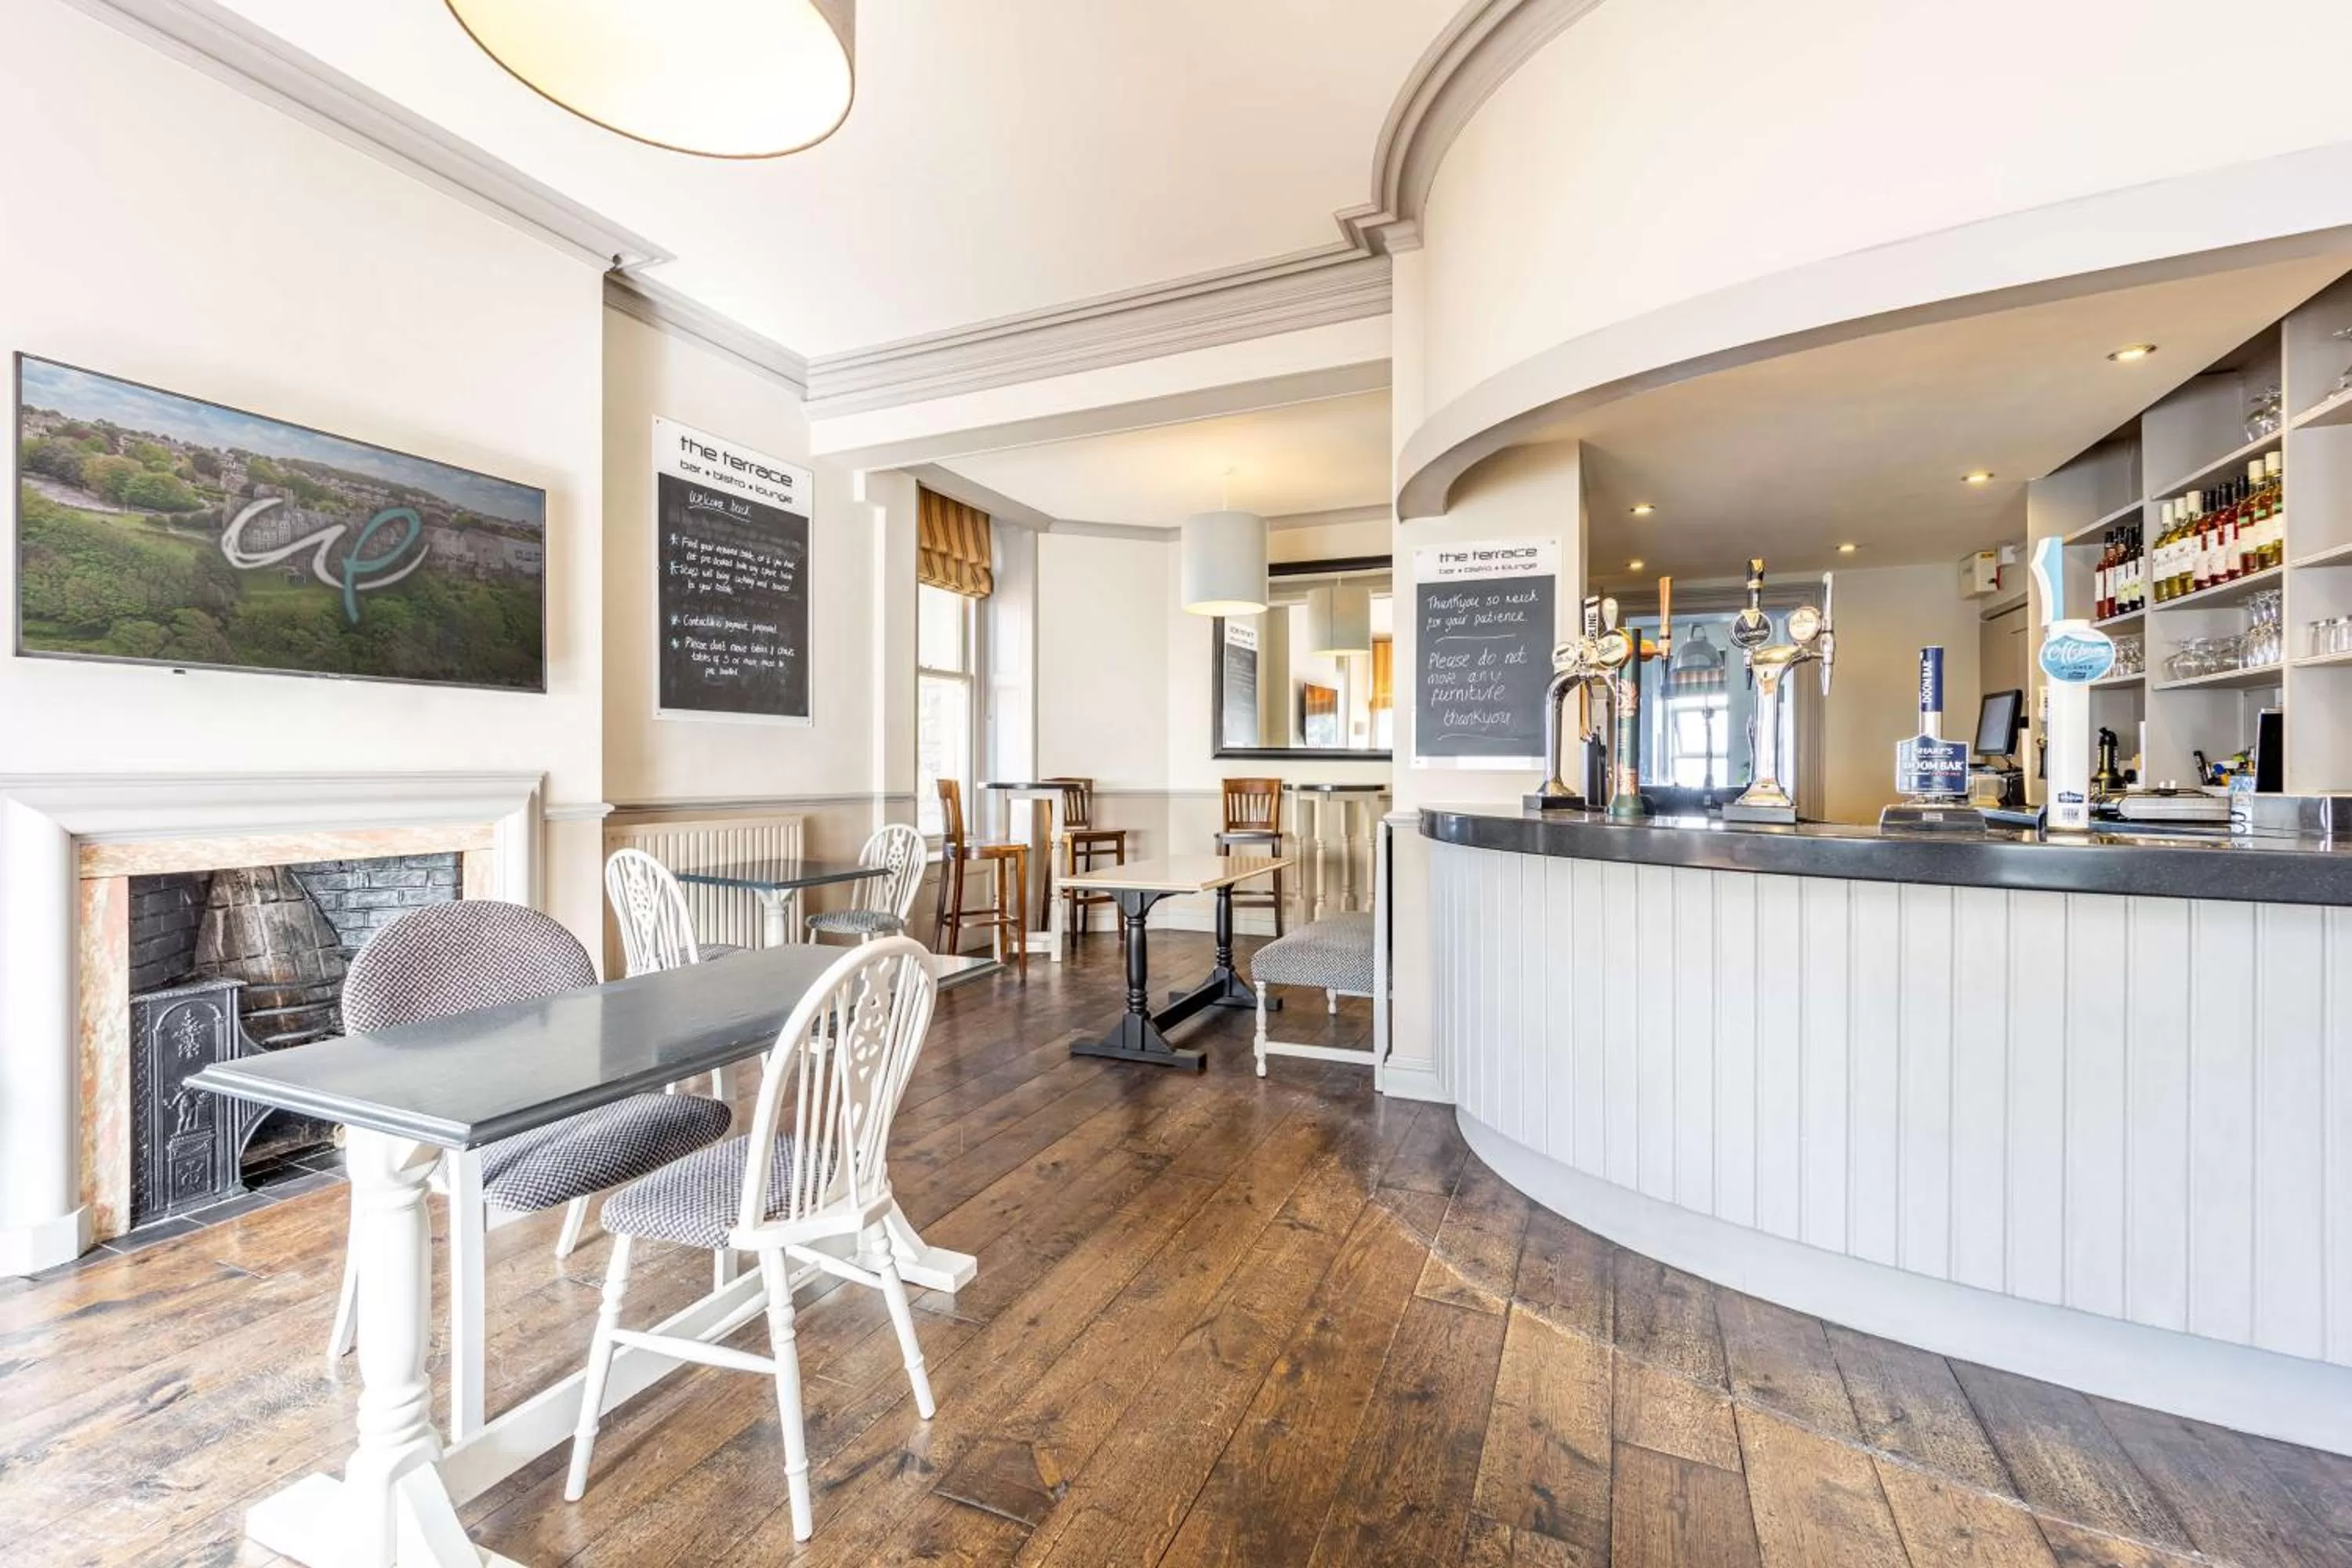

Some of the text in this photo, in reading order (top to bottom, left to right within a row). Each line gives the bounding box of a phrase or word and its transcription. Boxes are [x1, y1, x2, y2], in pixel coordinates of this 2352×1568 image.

[681, 436, 793, 487] the terrace
[680, 459, 793, 504] bar bistro lounge
[1439, 548, 1537, 563] the terrace
[1486, 595, 1500, 607] so
[1505, 588, 1540, 604] much
[1426, 616, 1443, 633] for
[1444, 614, 1468, 633] your
[1428, 644, 1529, 670] Please do not
[1427, 670, 1503, 685] move any
[1430, 683, 1506, 708] furniture
[1903, 760, 1965, 771] DOOM BAR
